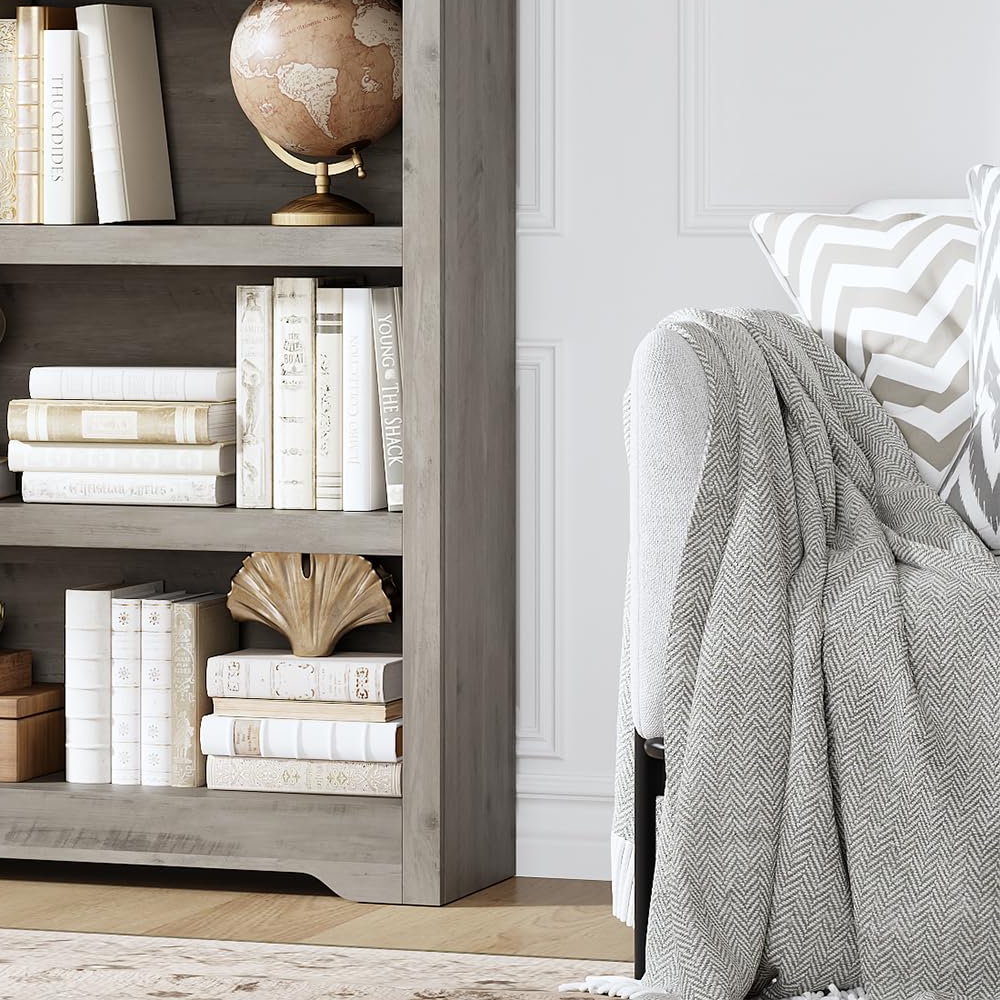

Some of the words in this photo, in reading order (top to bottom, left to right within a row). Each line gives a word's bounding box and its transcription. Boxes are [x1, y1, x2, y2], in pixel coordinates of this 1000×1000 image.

[51, 73, 64, 182] THUCYDIDES
[378, 313, 395, 368] YOUNG
[381, 382, 399, 413] THE
[384, 417, 403, 467] SHACK
